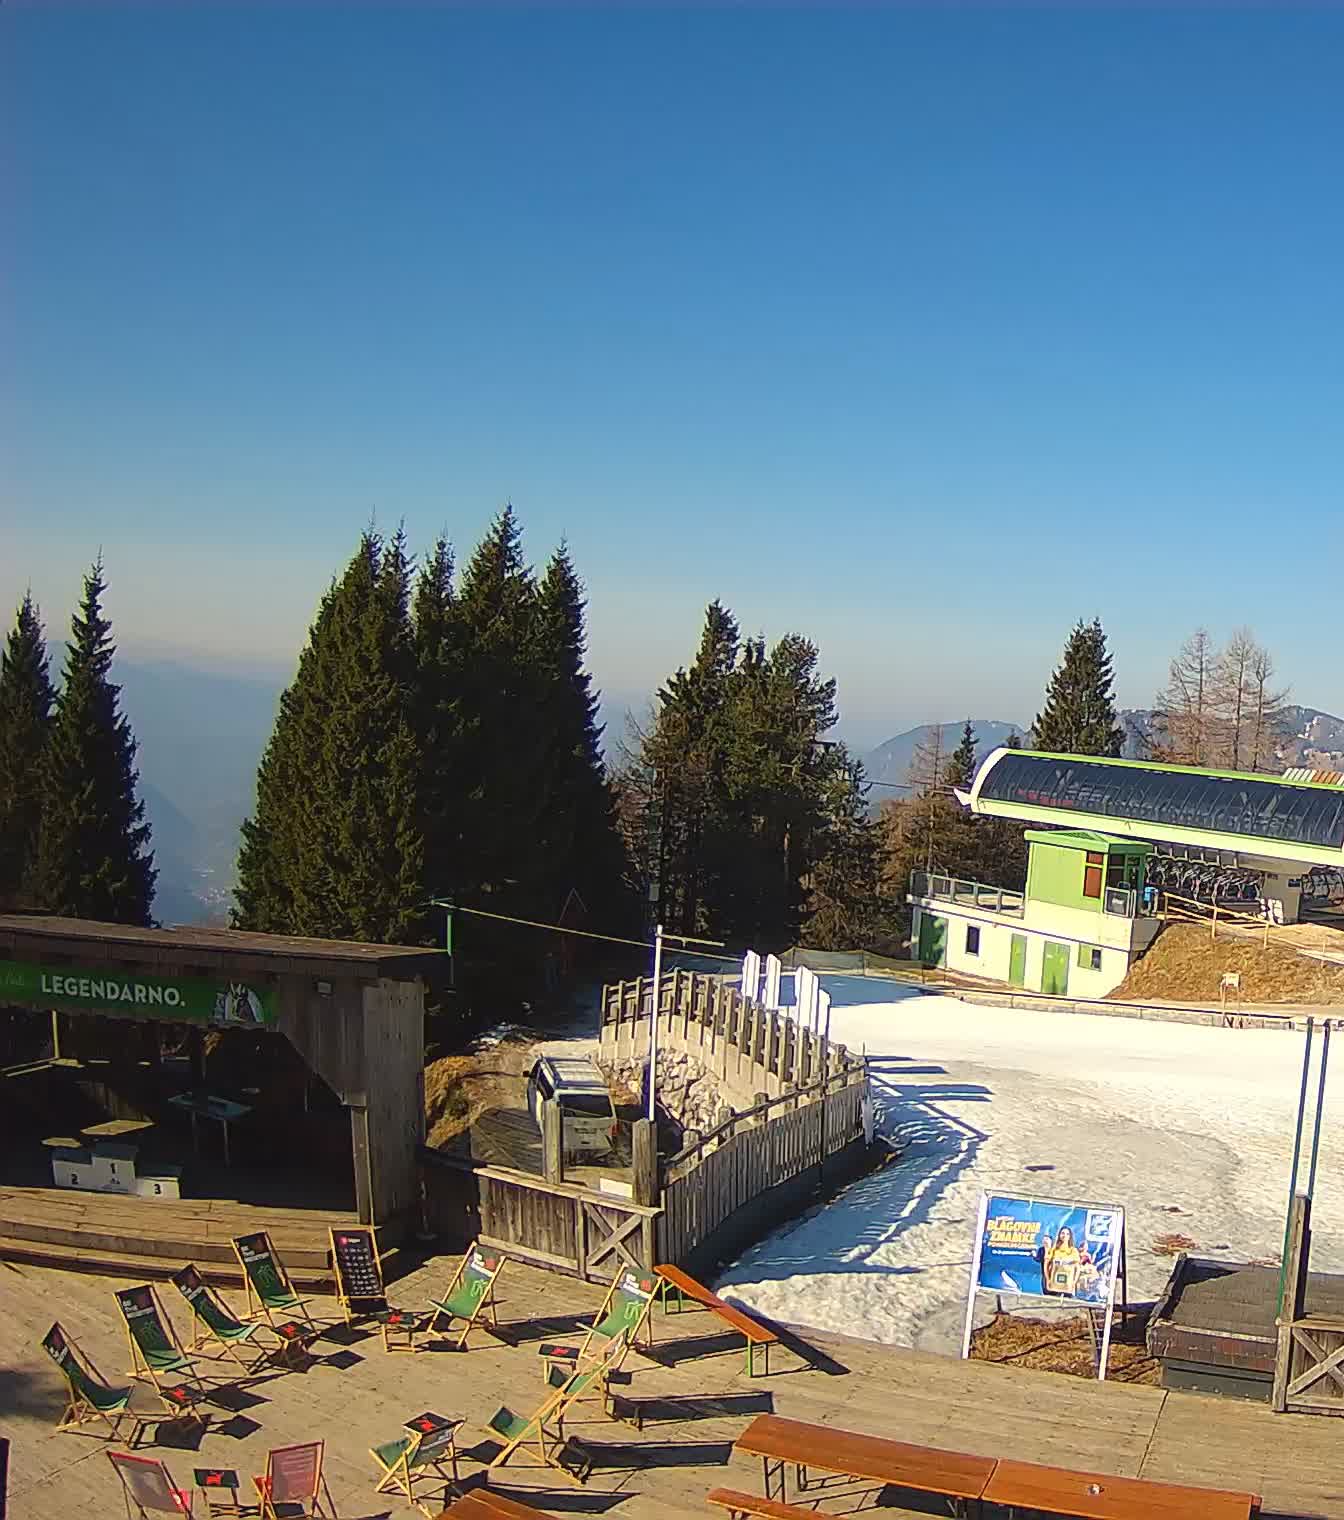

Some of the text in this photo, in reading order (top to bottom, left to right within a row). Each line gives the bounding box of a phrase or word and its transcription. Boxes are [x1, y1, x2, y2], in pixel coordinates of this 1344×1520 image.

[40, 973, 186, 1007] LEGENDARNO.
[109, 1162, 116, 1174] 1
[71, 1173, 79, 1185] 2
[153, 1183, 161, 1195] 3
